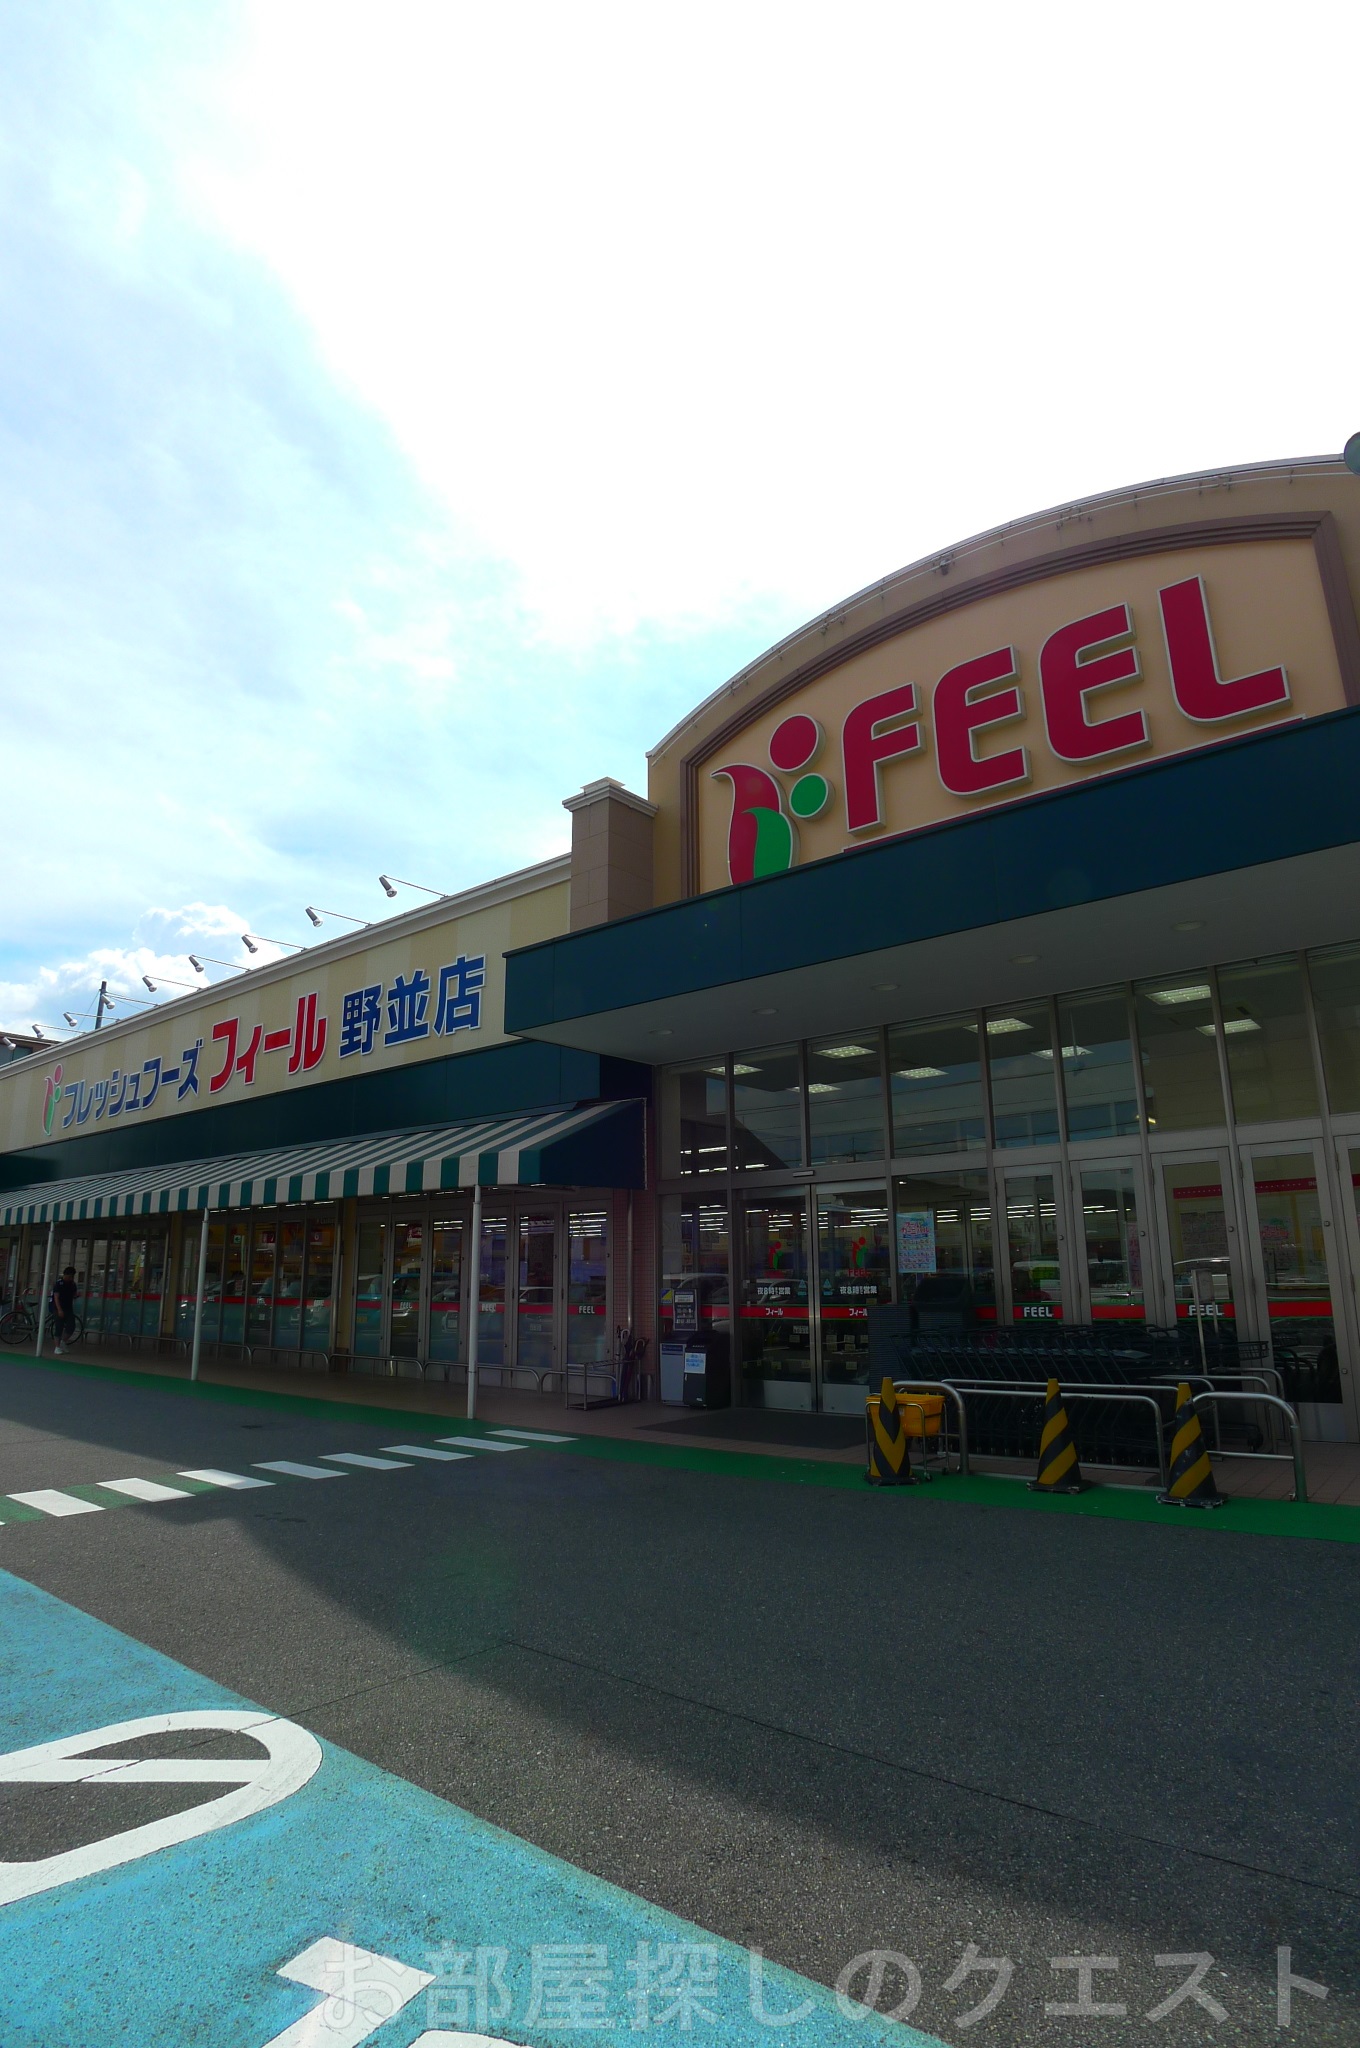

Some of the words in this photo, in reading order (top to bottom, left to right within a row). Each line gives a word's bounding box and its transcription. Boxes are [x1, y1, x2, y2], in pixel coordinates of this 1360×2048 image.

[842, 573, 1292, 835] FEEL
[62, 1038, 204, 1129] フレッシュフーズ
[209, 992, 328, 1093] フィール
[340, 953, 487, 1059] 野並店
[578, 1305, 596, 1314] FEEL
[765, 1307, 784, 1316] フィール
[1023, 1306, 1053, 1318] FEEL
